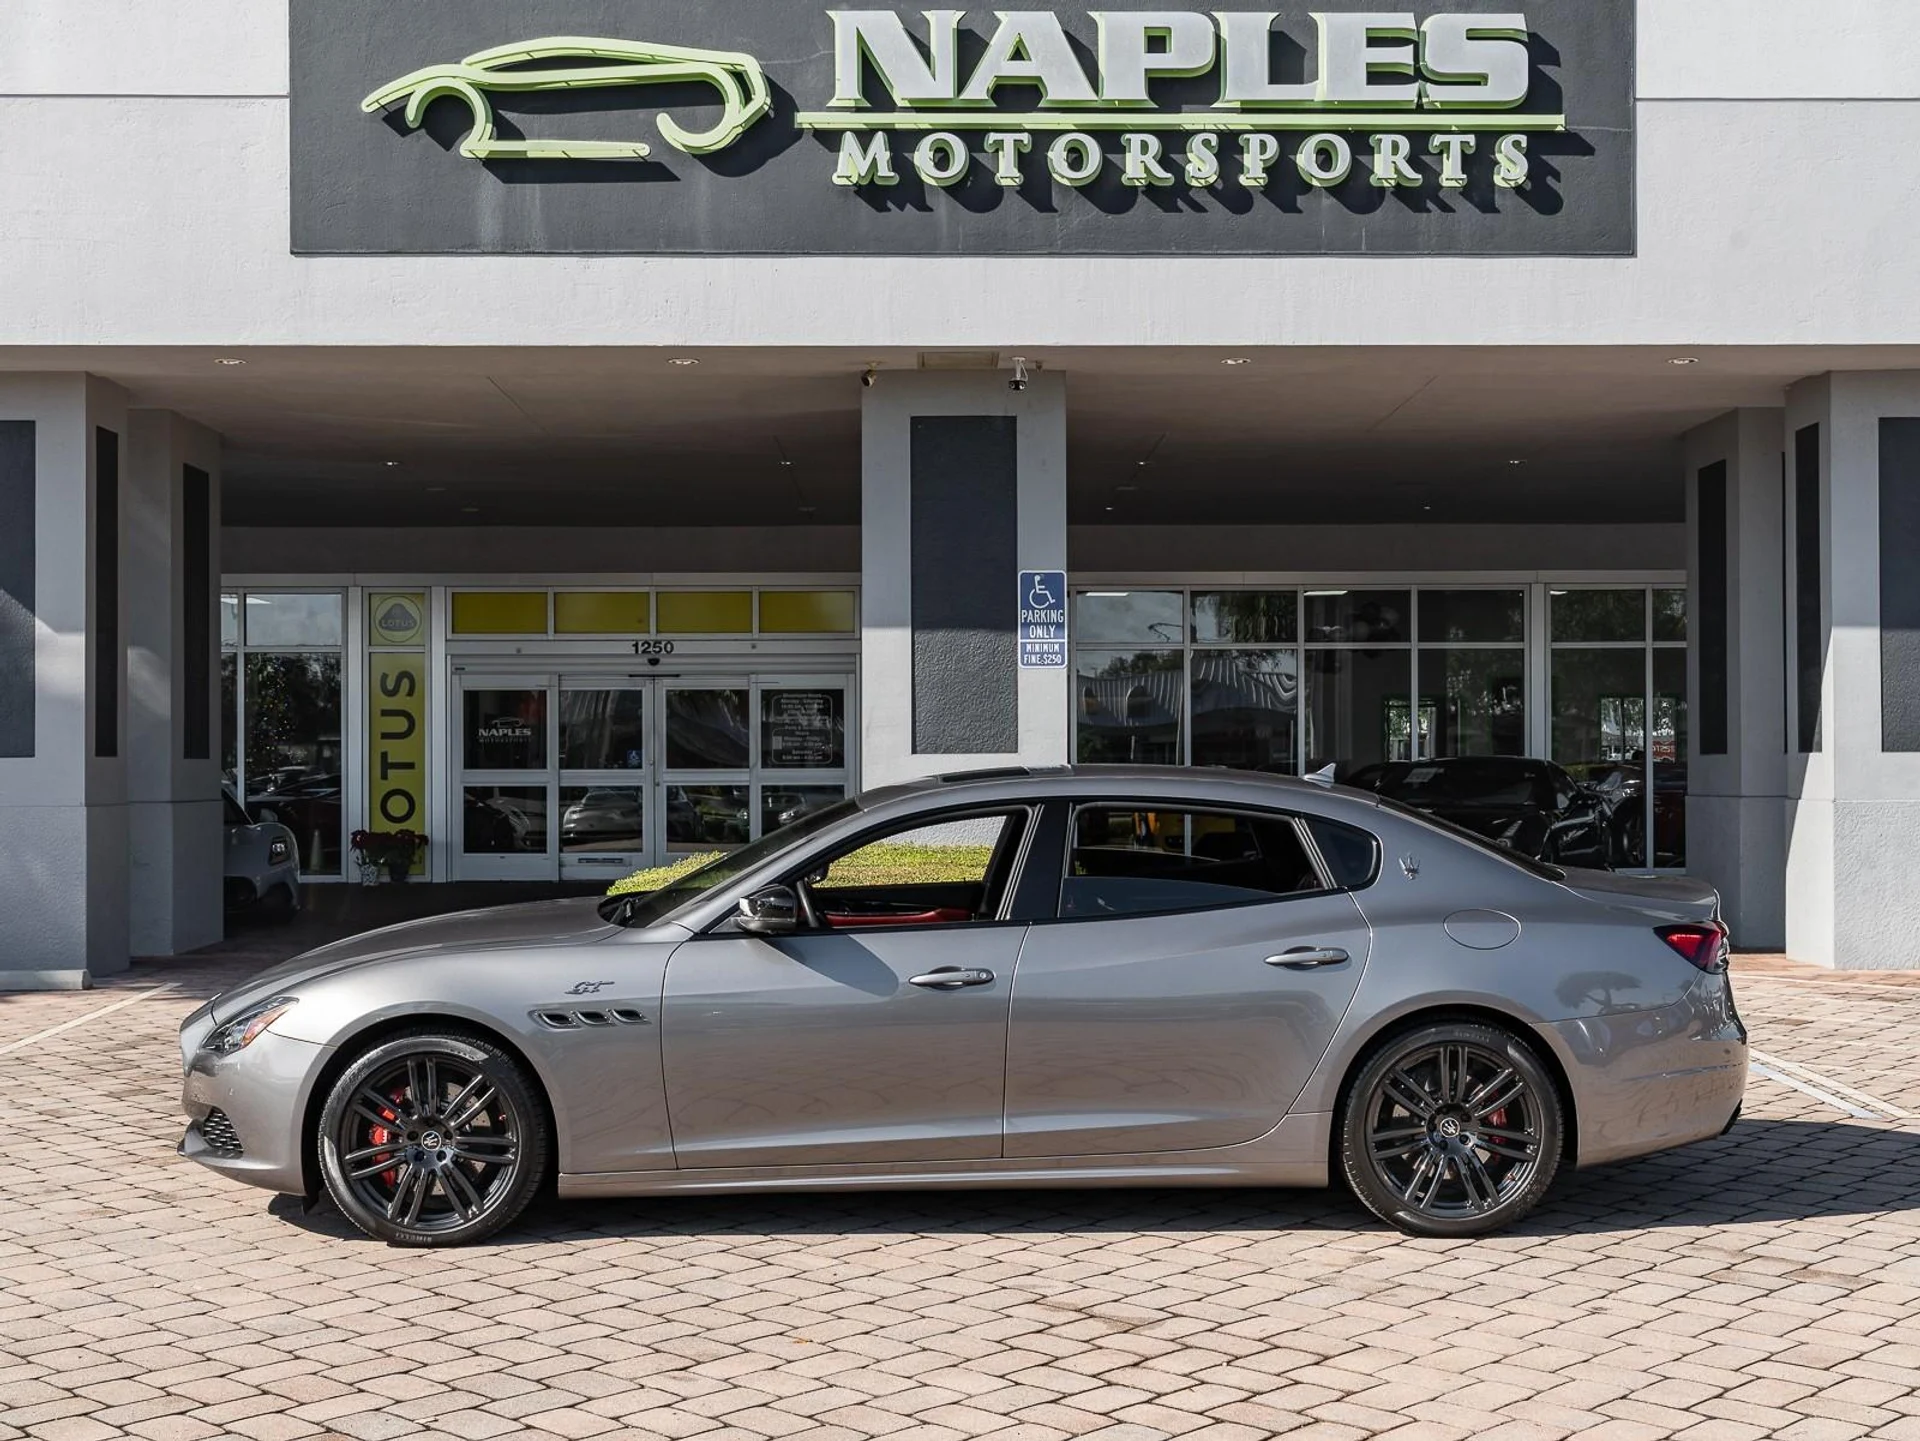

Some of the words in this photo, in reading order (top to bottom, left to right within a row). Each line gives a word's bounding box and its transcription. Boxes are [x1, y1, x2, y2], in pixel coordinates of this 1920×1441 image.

[826, 10, 1529, 108] NAPLES
[832, 130, 1530, 187] MOTORSPORTS
[1021, 609, 1064, 623] PARKING
[1029, 625, 1056, 638] ONLY
[631, 640, 674, 655] 1250
[1026, 643, 1060, 653] MINIMUM
[478, 728, 532, 737] NAPLES
[380, 670, 416, 823] OTUS
